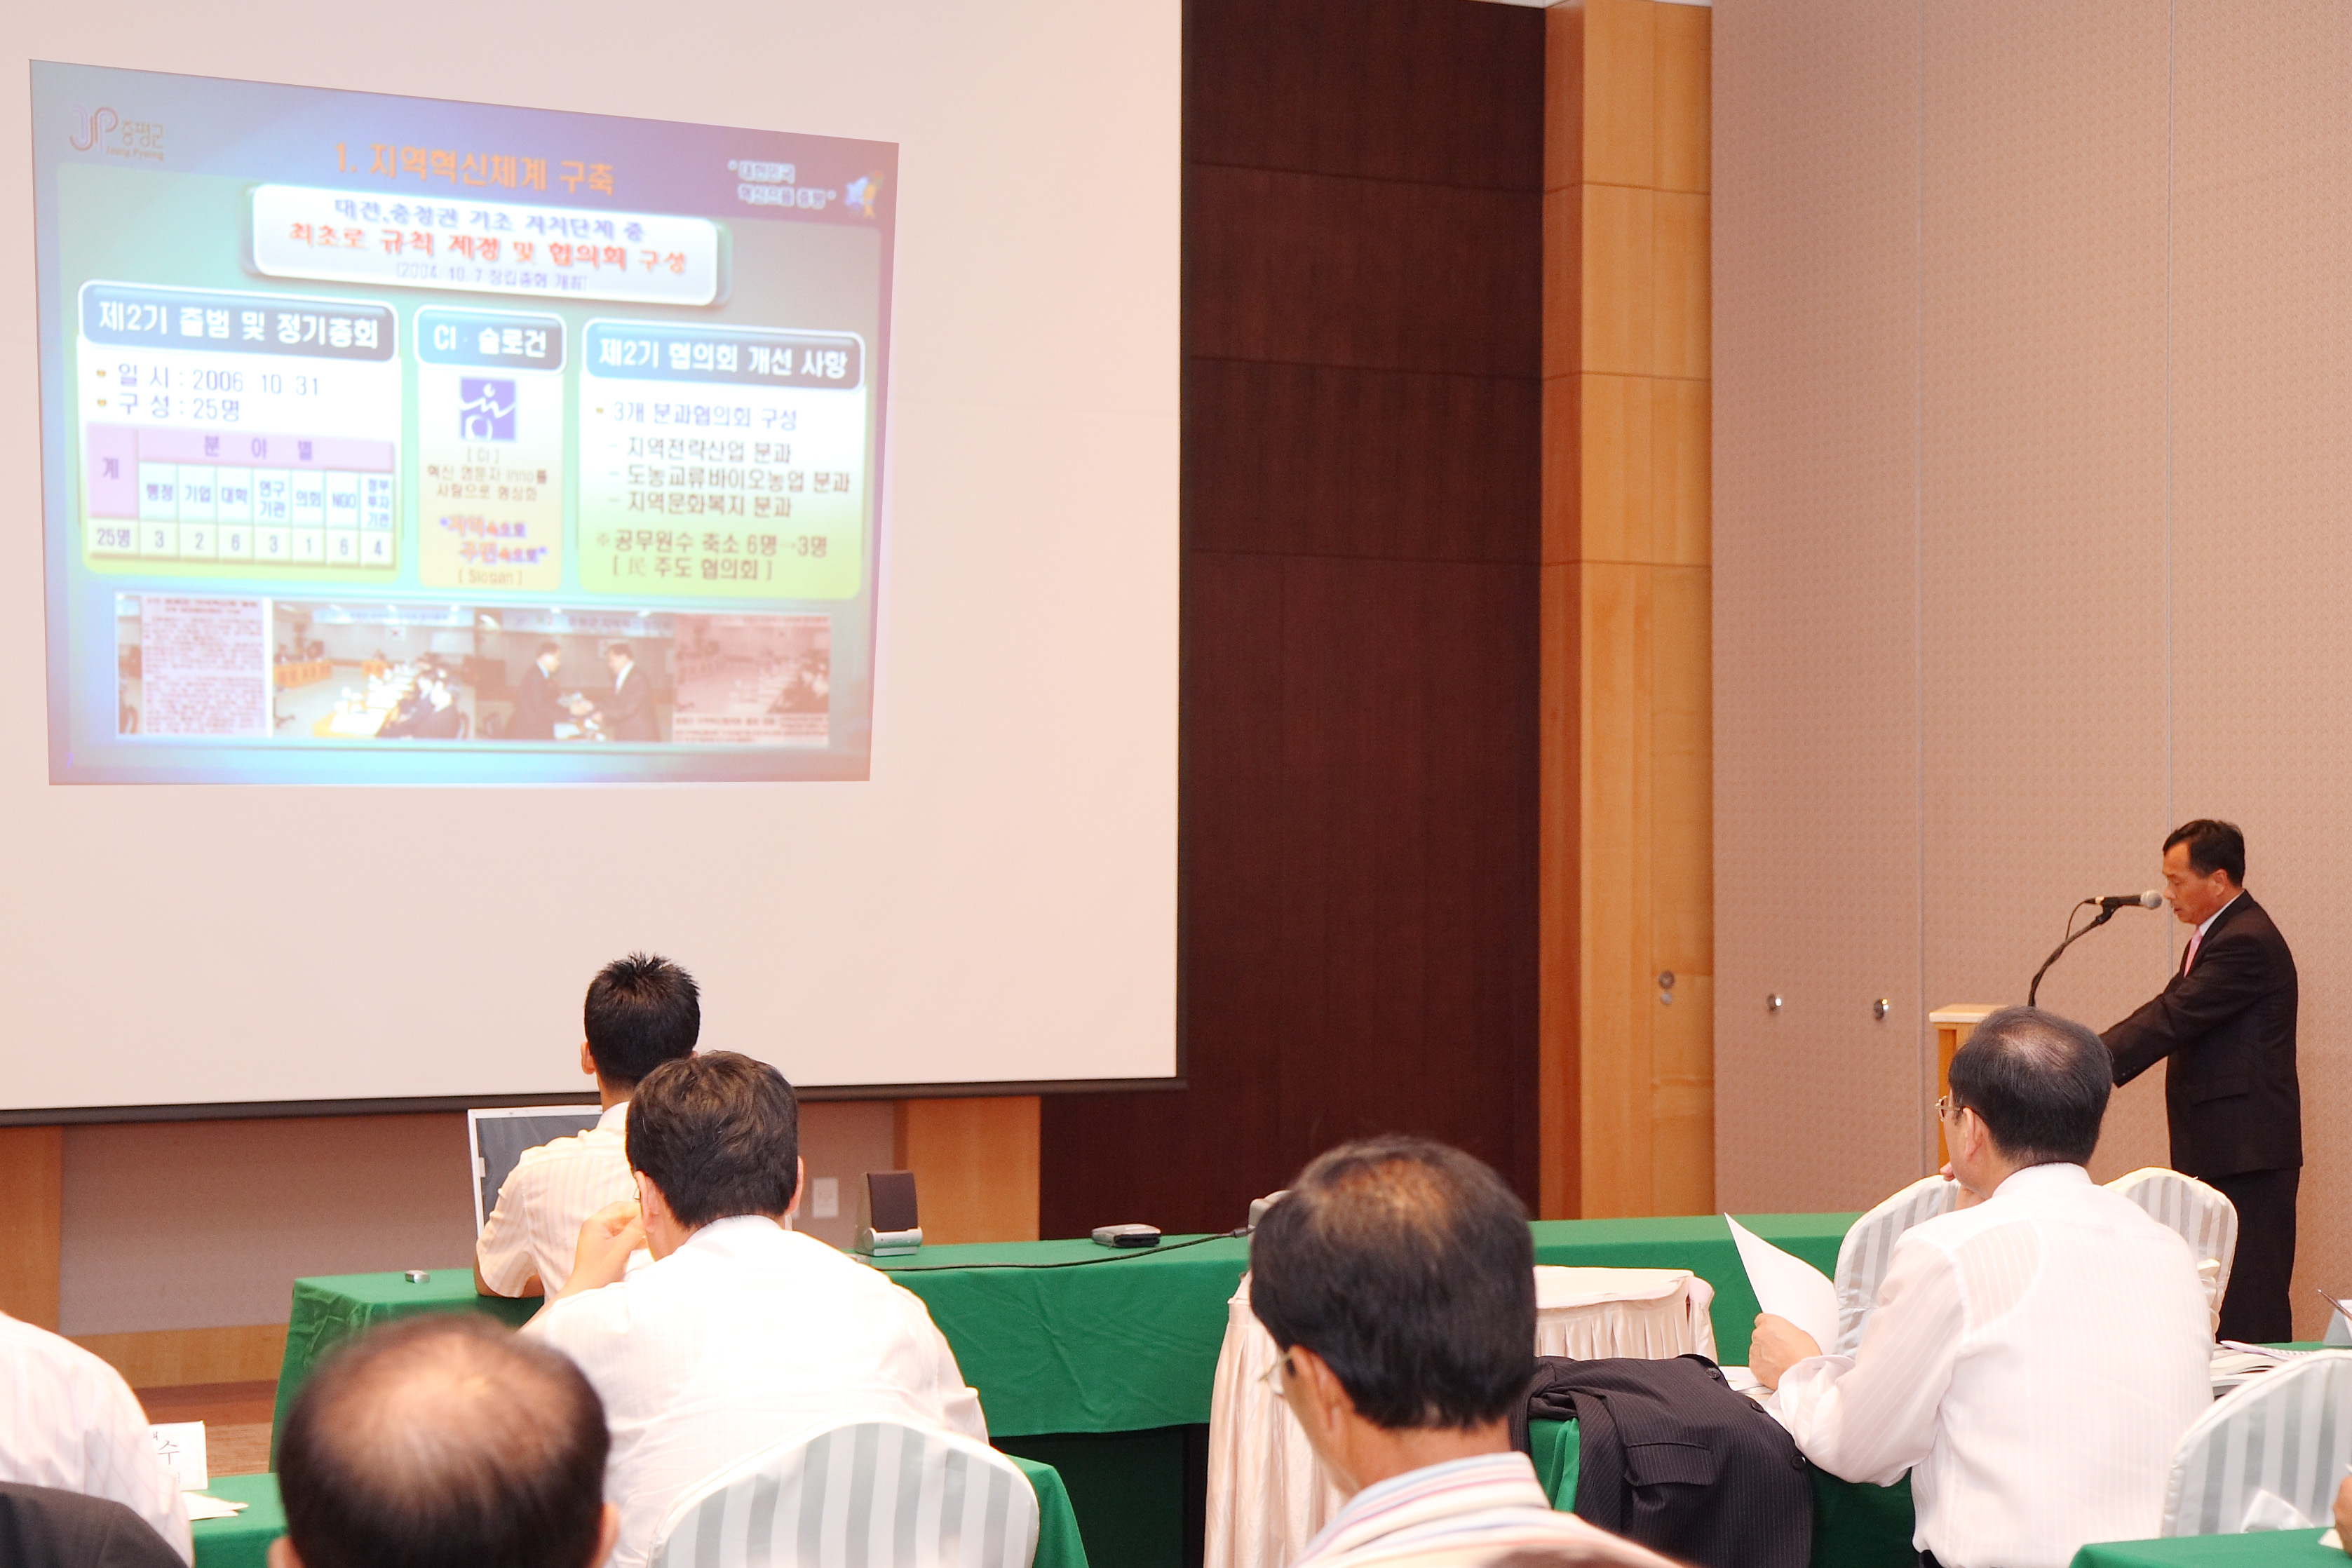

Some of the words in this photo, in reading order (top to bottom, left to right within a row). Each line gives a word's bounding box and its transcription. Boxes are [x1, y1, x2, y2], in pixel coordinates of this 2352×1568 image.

[121, 120, 164, 149] 증평군
[334, 142, 357, 173] 1.
[370, 142, 547, 191] 지역혁신체계
[560, 161, 614, 196] 구축
[469, 209, 513, 232] 기초
[525, 215, 615, 241] 자치단체
[623, 221, 644, 243] 중
[290, 222, 369, 249] 최초로
[380, 229, 434, 258] 규칙
[447, 234, 501, 262] 제정
[513, 241, 535, 264] 및
[548, 241, 627, 272] 협의회
[638, 249, 686, 275] 구성
[98, 301, 167, 334] 제2기
[180, 306, 229, 339] 출범
[242, 311, 264, 342] 및
[277, 313, 378, 349] 정기총회
[433, 324, 457, 351] CI
[478, 327, 546, 358] 슬로건
[599, 337, 658, 368] 제2기
[668, 342, 738, 372] 협의회
[748, 346, 792, 376] 개선
[801, 349, 848, 379] 사항
[296, 376, 318, 396] 31
[194, 398, 239, 422] 25명
[614, 401, 644, 423] 3개
[654, 403, 751, 428] 분과협의회
[761, 407, 797, 431] 구성
[628, 436, 745, 464] 지역전략산업
[755, 442, 792, 465] 분과
[628, 464, 804, 492] 도농교류바이오농업
[813, 471, 851, 494] 분과
[185, 485, 210, 503] 기업
[628, 491, 745, 516] 지역문화복지
[754, 496, 792, 518] 분과
[97, 527, 130, 548] 25명
[155, 530, 164, 548] 3
[195, 532, 204, 550] 2
[231, 534, 240, 551] 6
[269, 535, 278, 553] 3
[374, 540, 382, 556] 4
[615, 529, 694, 554] 공무원수
[703, 532, 740, 555] 축소
[654, 557, 693, 579] 주도
[701, 559, 758, 581] 협의회
